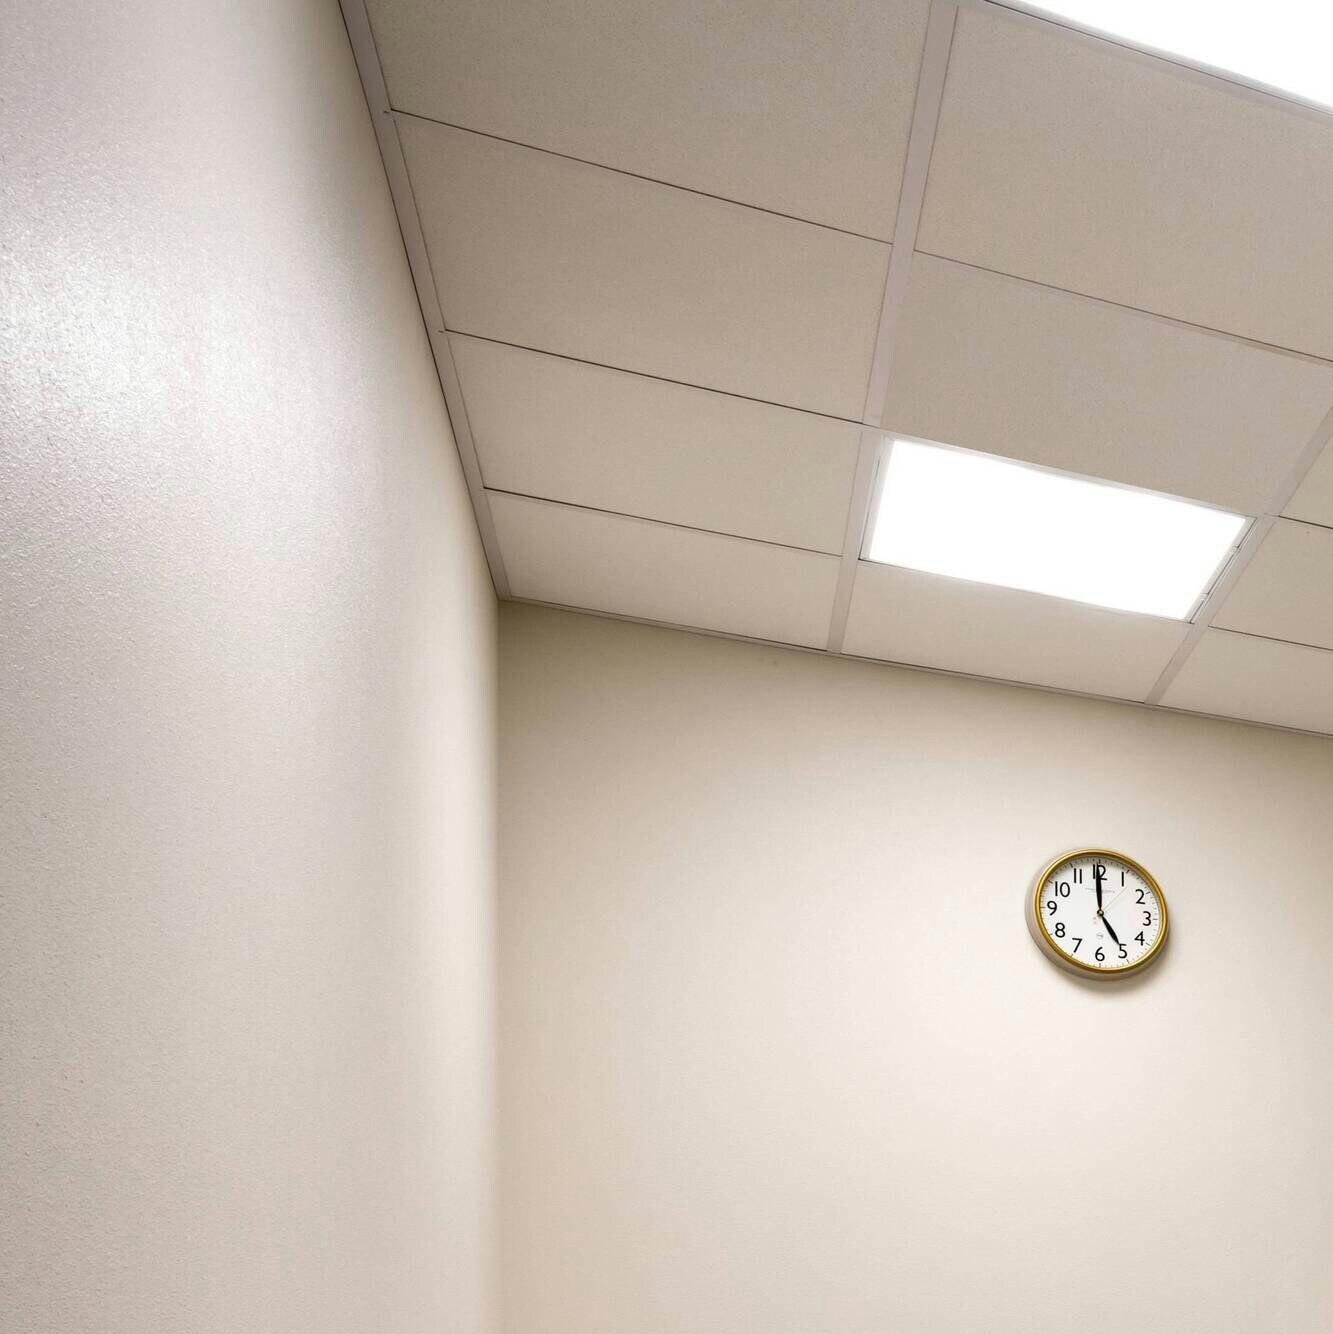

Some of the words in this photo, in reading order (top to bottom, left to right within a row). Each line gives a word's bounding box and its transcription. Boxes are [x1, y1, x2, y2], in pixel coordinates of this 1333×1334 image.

[1074, 868, 1082, 883] 11
[1093, 864, 1107, 880] 12
[1121, 872, 1124, 886] 1
[1055, 881, 1070, 897] 10
[1136, 889, 1145, 904] 2
[1047, 901, 1057, 915] 9
[1143, 911, 1151, 926] 3
[1055, 923, 1065, 938] 8
[1072, 938, 1082, 952] 7
[1135, 931, 1144, 946] 4
[1095, 947, 1104, 961] 6
[1118, 944, 1127, 958] 5
